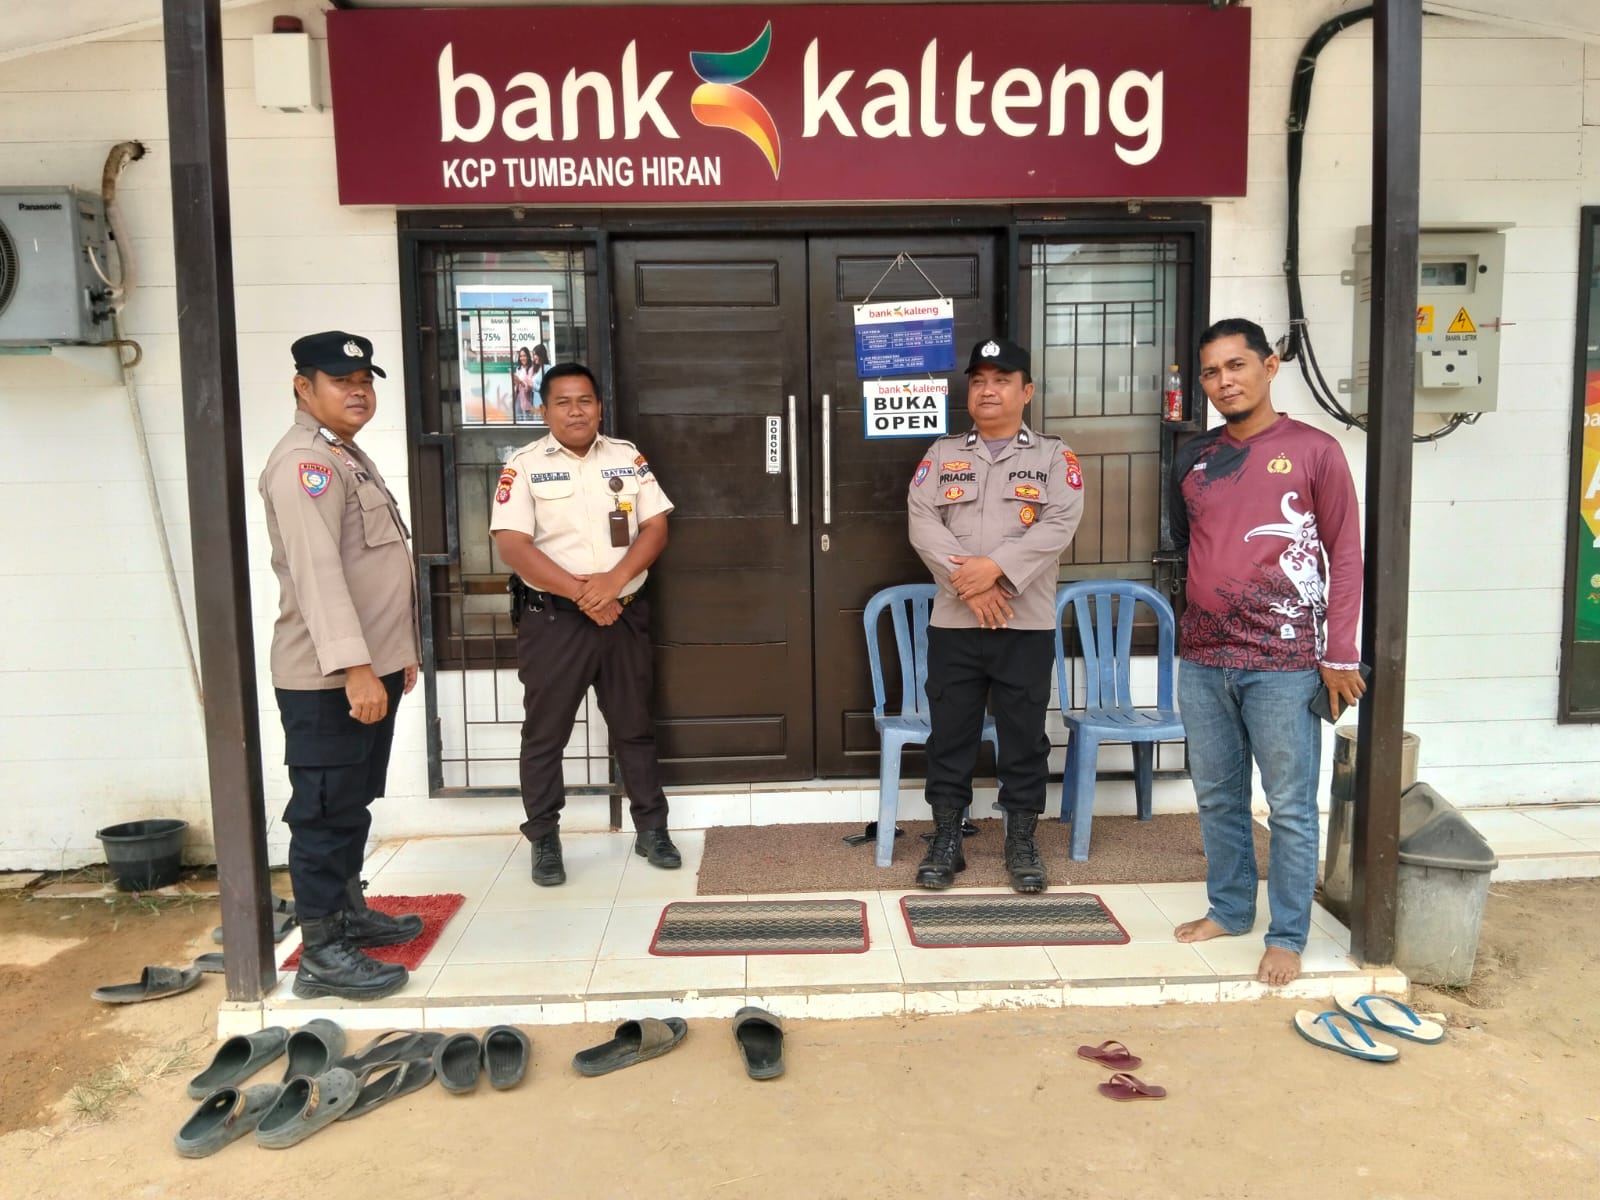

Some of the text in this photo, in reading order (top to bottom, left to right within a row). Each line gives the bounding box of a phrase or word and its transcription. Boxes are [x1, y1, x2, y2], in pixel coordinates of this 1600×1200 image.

[438, 37, 1164, 166] bank kalteng
[443, 157, 721, 188] KCP TUMBANG HIRAN
[19, 203, 62, 211] Panasonic
[869, 306, 939, 318] bank kalteng
[879, 384, 947, 395] bank kalteng
[874, 396, 937, 411] BUKA
[875, 415, 938, 430] OPEN
[939, 472, 976, 484] PRIADIE
[1008, 470, 1048, 483] POLRI
